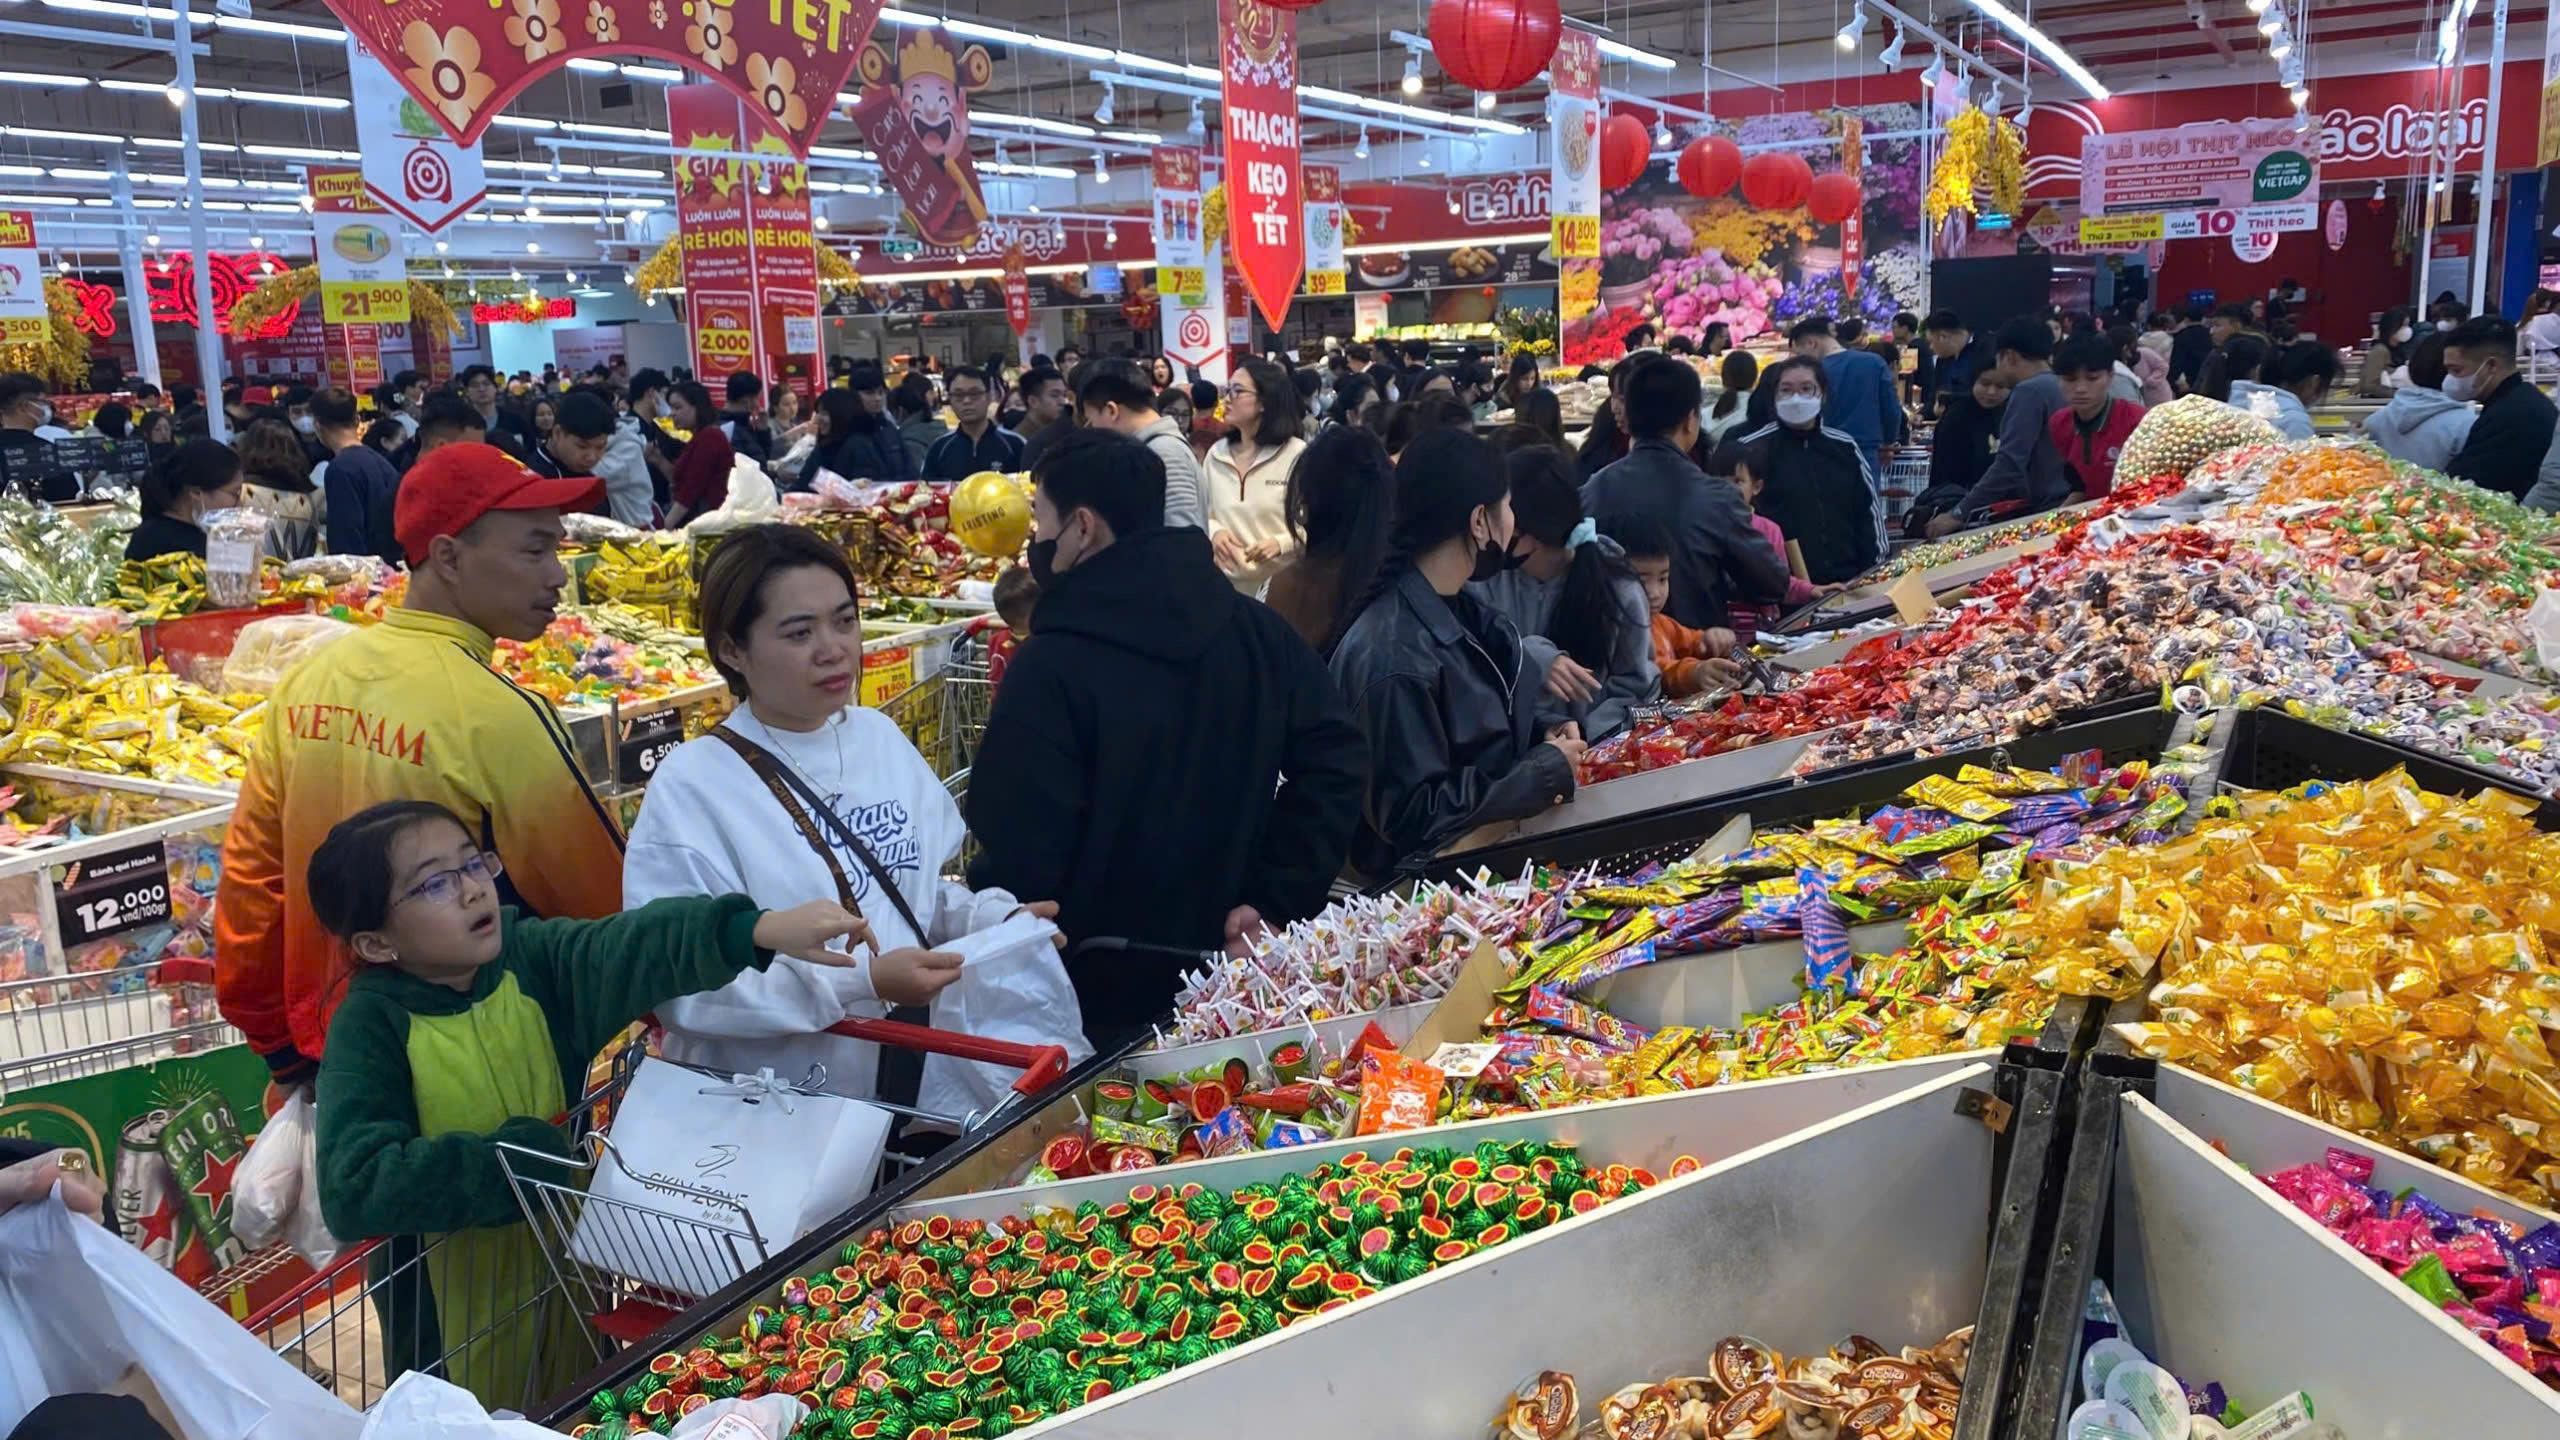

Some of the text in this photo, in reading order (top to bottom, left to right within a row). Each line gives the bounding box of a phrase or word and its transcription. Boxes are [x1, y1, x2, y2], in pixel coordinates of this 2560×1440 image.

[1228, 106, 1297, 152] THẠCH
[2188, 133, 2240, 155] THỊT
[317, 175, 362, 194] Khuyế
[1247, 161, 1288, 202] KẸO
[1468, 183, 1552, 219] Bánh
[685, 208, 741, 223] LUÔN LUÔN
[756, 208, 807, 221] LUÔN LUÔN
[1252, 200, 1288, 246] TẾT
[2247, 216, 2305, 229] Thịt heo
[683, 225, 748, 250] RẺ HƠN
[754, 223, 812, 248] RẺ HƠN
[2250, 232, 2272, 247] 10
[0, 320, 42, 341] 500
[712, 315, 737, 329] TRÊN
[701, 333, 750, 351] 2.000
[793, 793, 908, 850] Vtage
[76, 885, 165, 933] 12.000
[644, 1172, 695, 1199] SKIN
[117, 1188, 143, 1245] ILVER
